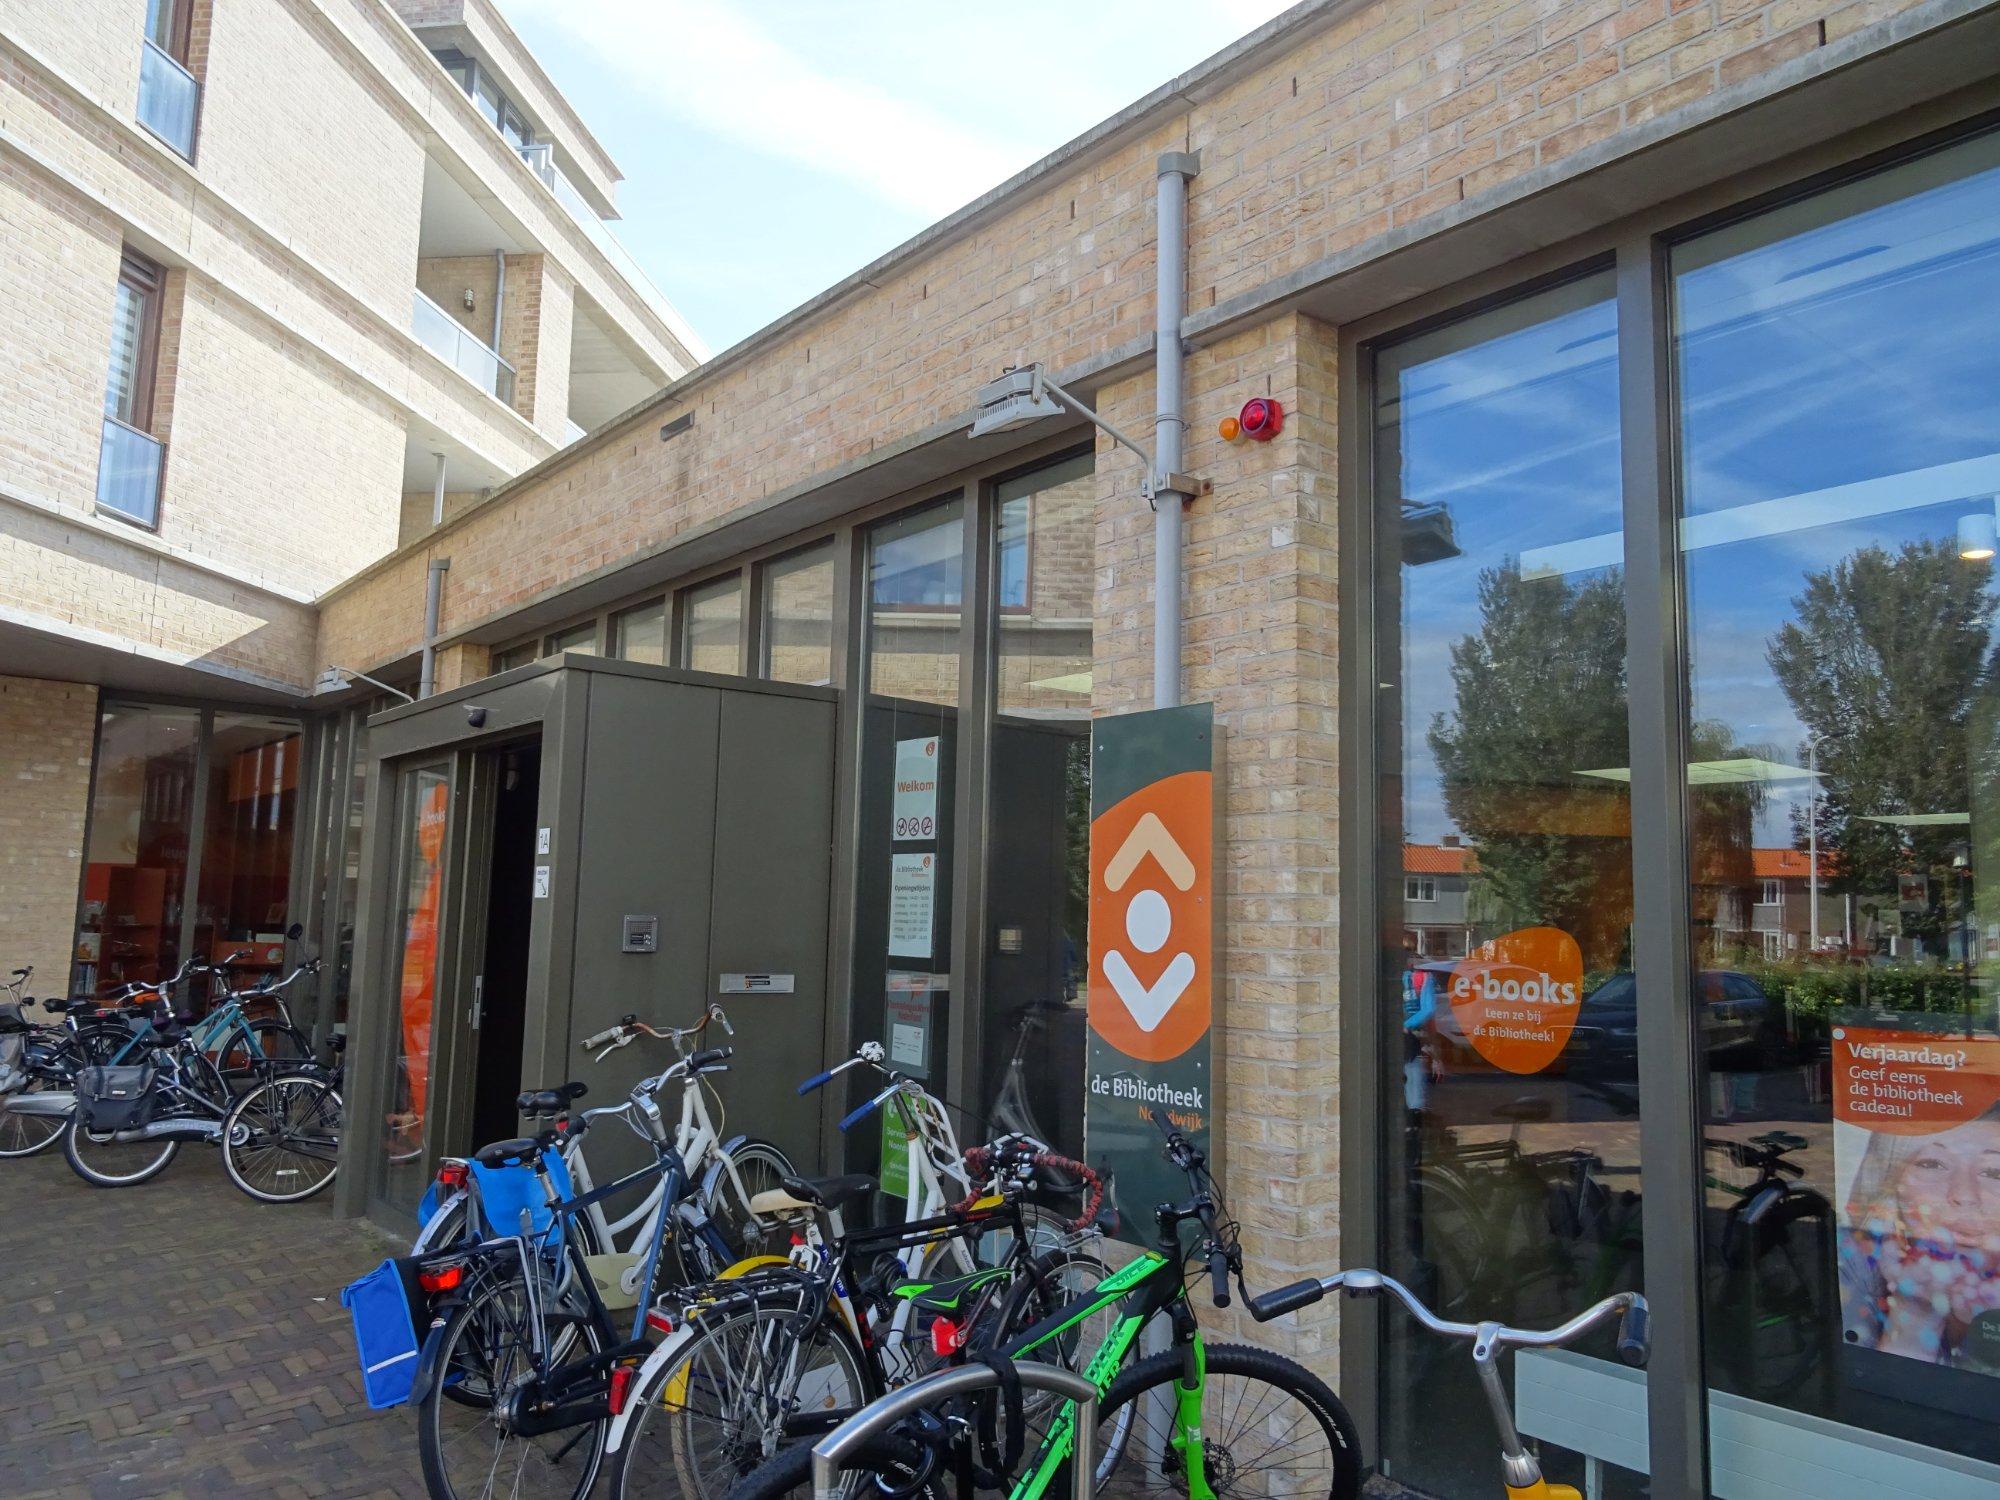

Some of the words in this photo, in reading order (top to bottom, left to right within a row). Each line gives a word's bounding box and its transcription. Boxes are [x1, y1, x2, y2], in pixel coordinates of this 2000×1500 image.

[897, 780, 934, 793] Welkom
[1454, 969, 1576, 1005] e-books
[1485, 1007, 1510, 1020] Leen
[1512, 1011, 1525, 1021] ze
[1527, 1010, 1541, 1024] bij
[1473, 1025, 1486, 1036] de
[1488, 1026, 1555, 1042] Bibliotheek!
[1848, 1042, 1966, 1071] Verjaardag?
[1849, 1066, 1886, 1081] Geef
[1890, 1073, 1926, 1085] eens
[1091, 1074, 1110, 1095] de
[1113, 1078, 1203, 1108] Bibliotheek
[1849, 1082, 1869, 1096] de
[1873, 1084, 1964, 1106] bibliotheek
[1139, 1106, 1202, 1132] Nodwijk
[1850, 1100, 1912, 1117] cadeau!
